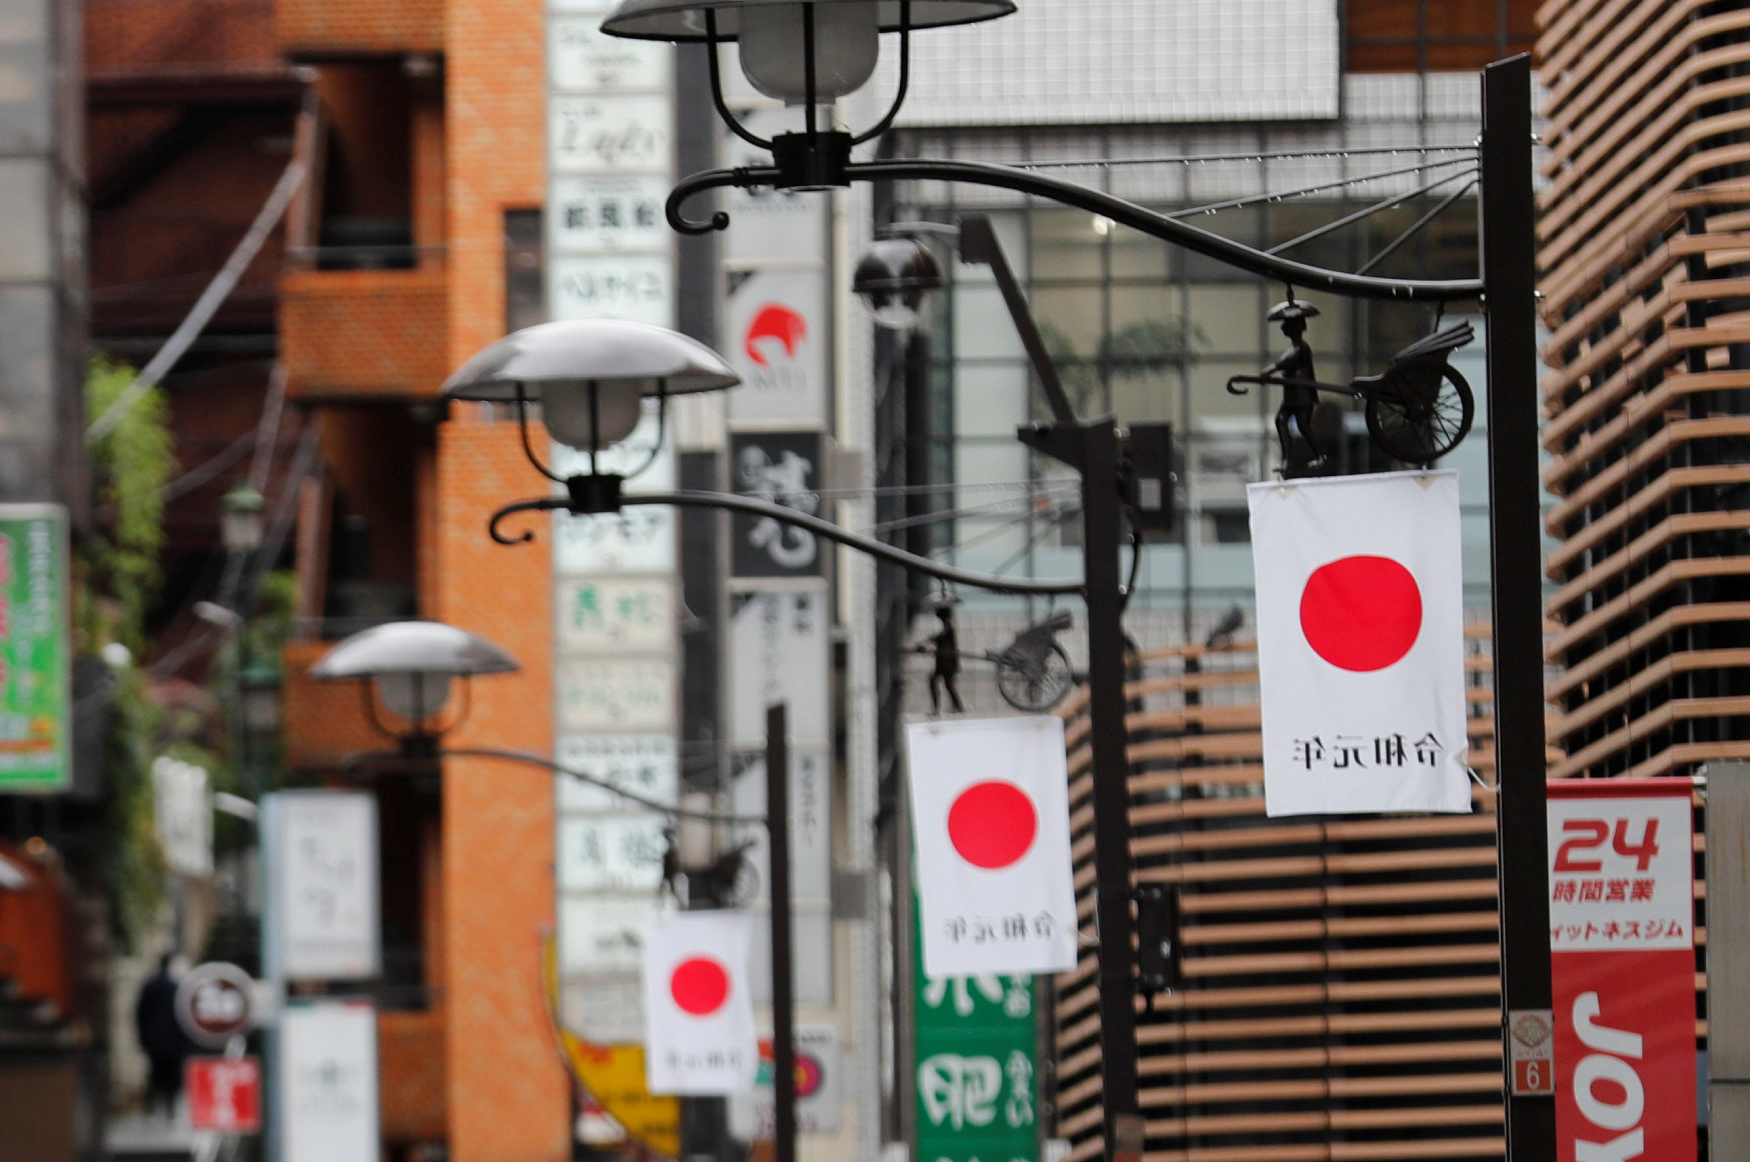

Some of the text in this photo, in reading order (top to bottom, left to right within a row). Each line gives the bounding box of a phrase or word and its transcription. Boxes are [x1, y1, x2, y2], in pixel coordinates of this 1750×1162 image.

[1554, 818, 1660, 873] 24
[1552, 878, 1656, 903] 時間営業
[1525, 1060, 1541, 1090] 6
